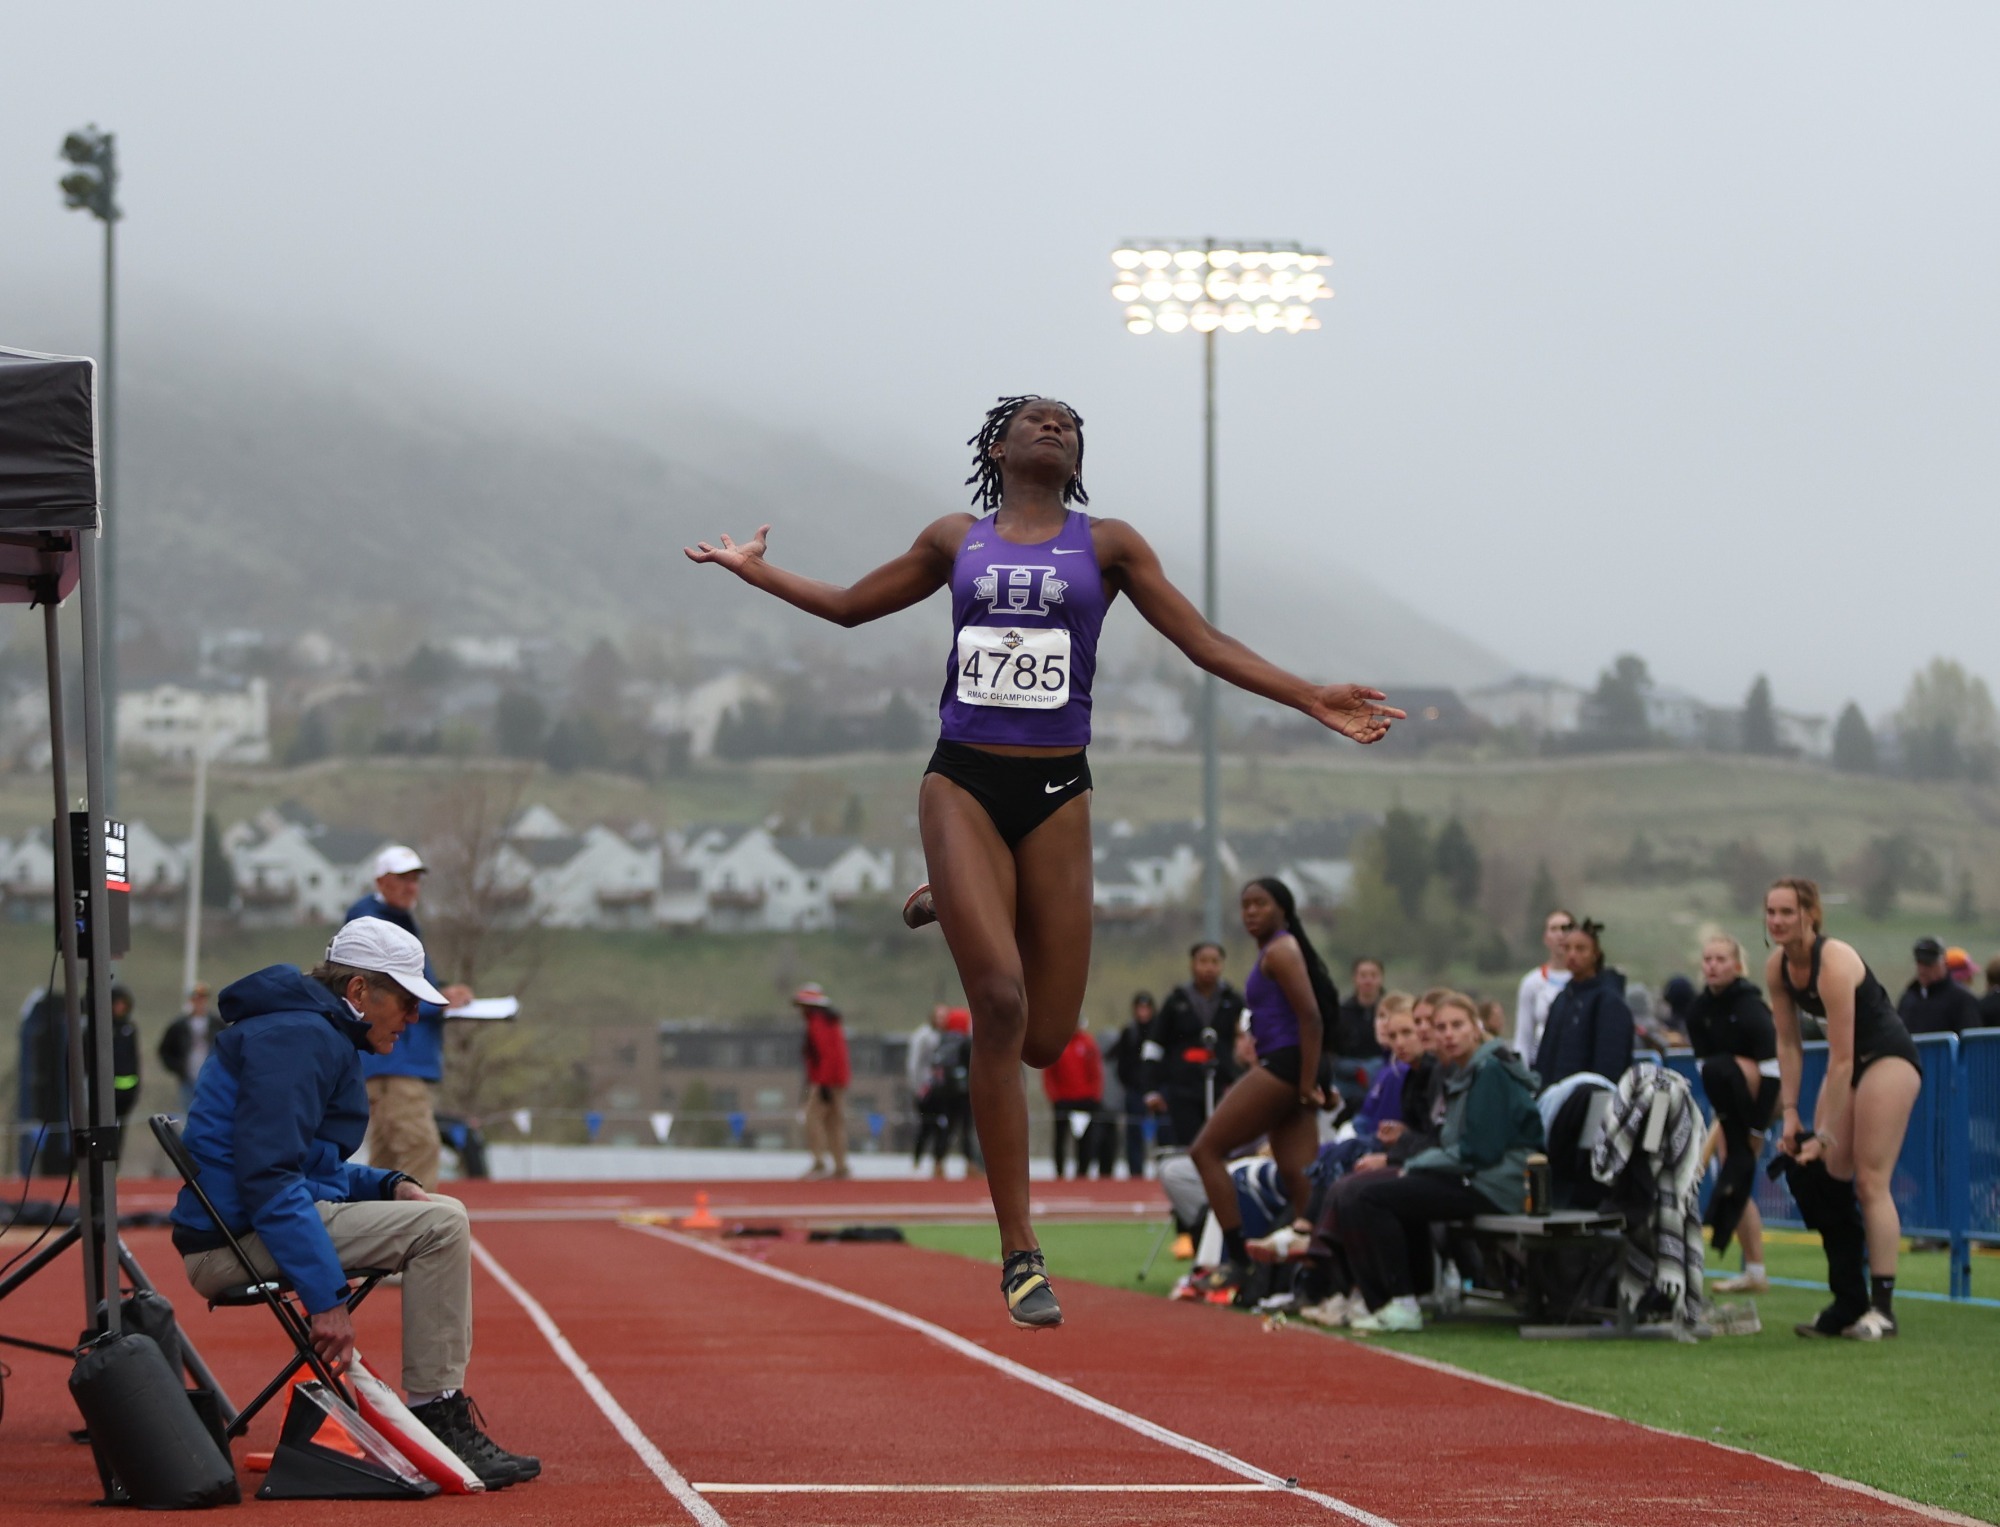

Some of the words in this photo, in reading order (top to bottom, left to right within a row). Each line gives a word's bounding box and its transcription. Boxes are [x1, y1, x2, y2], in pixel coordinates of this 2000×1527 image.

[986, 564, 1056, 617] H
[1002, 636, 1024, 646] RMAC
[963, 651, 1065, 692] 4785
[967, 690, 988, 700] RMAC
[990, 692, 1058, 703] CHAMPIONSHIP
